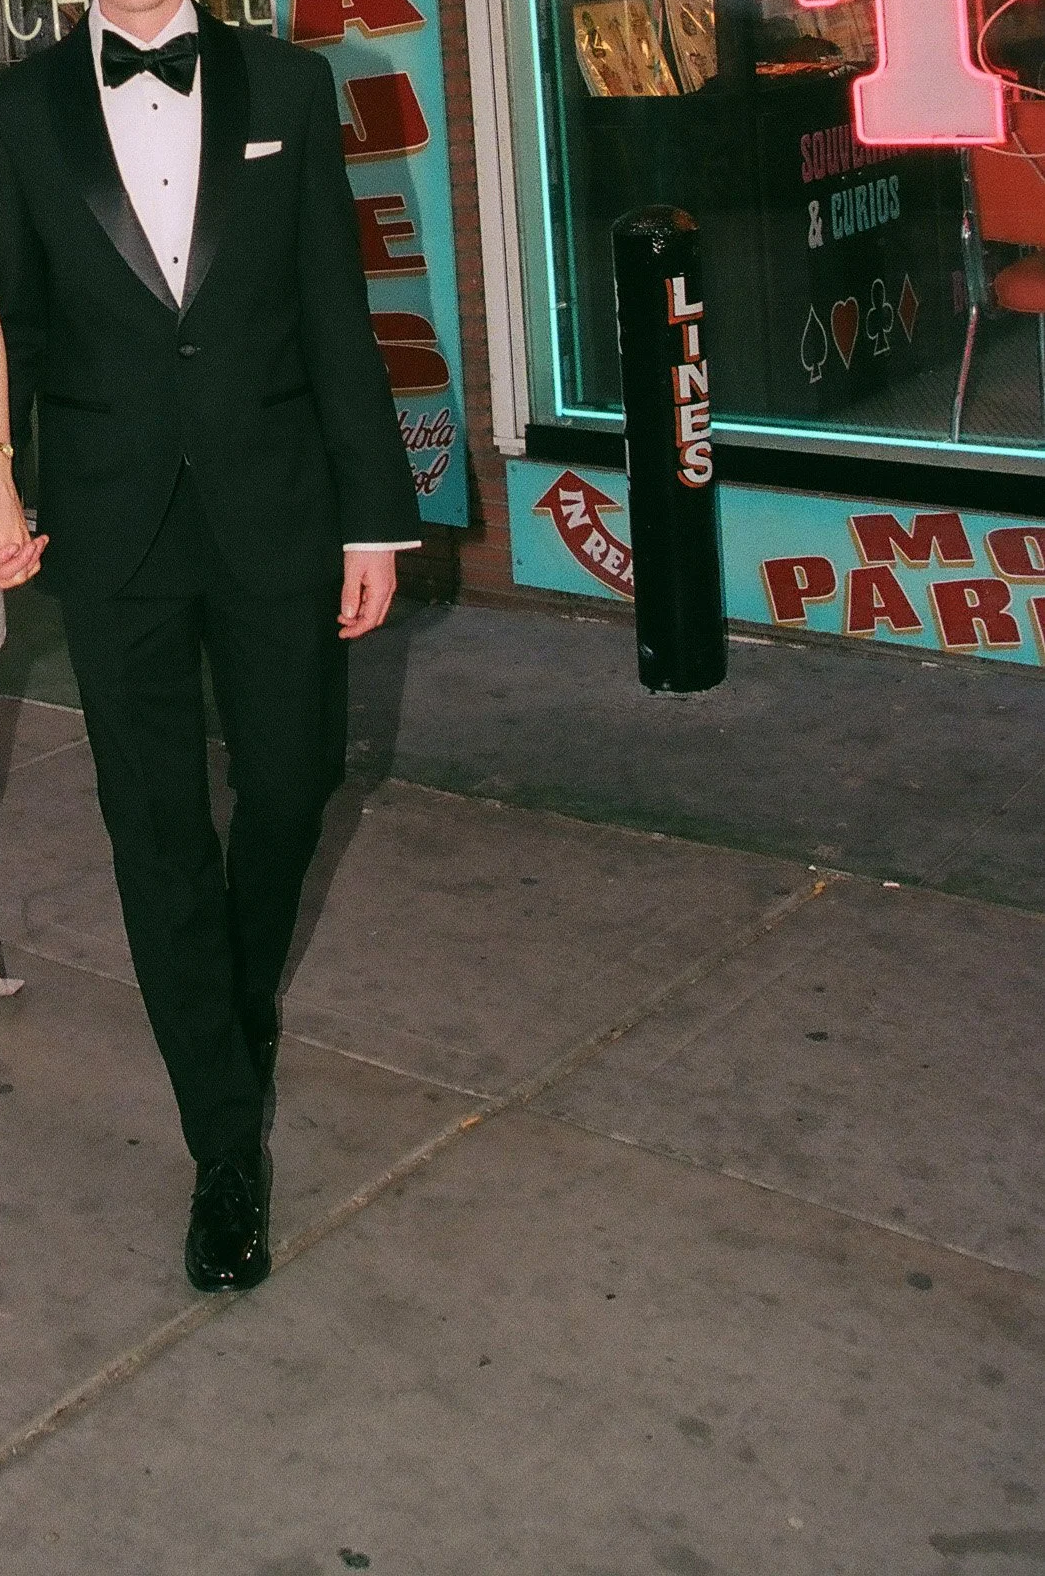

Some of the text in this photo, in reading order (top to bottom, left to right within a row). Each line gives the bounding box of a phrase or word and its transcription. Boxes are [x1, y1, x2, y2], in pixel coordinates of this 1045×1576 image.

[807, 175, 900, 249] & CURIOS
[666, 276, 713, 489] LINES
[558, 487, 593, 530] IN
[759, 555, 1045, 667] PAR
